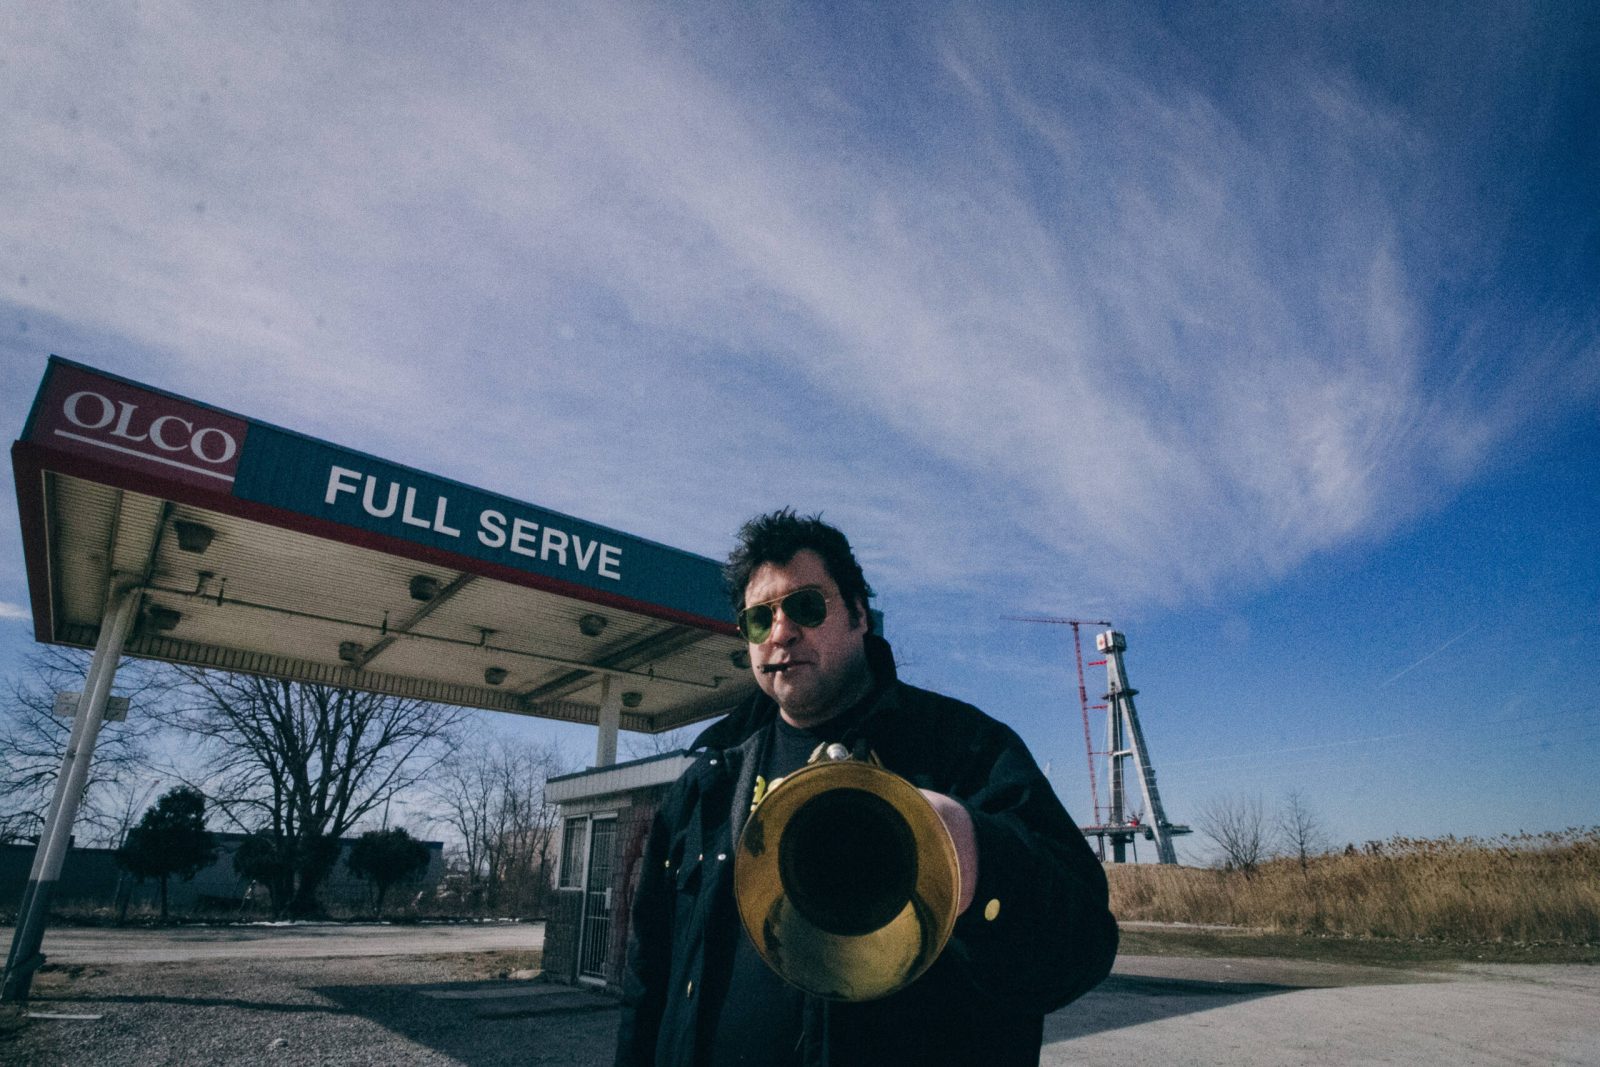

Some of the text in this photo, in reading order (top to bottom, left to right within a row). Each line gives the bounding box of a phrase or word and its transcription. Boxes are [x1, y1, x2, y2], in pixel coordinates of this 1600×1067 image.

[63, 391, 236, 463] OLCO
[325, 465, 622, 580] FULL SERVE
